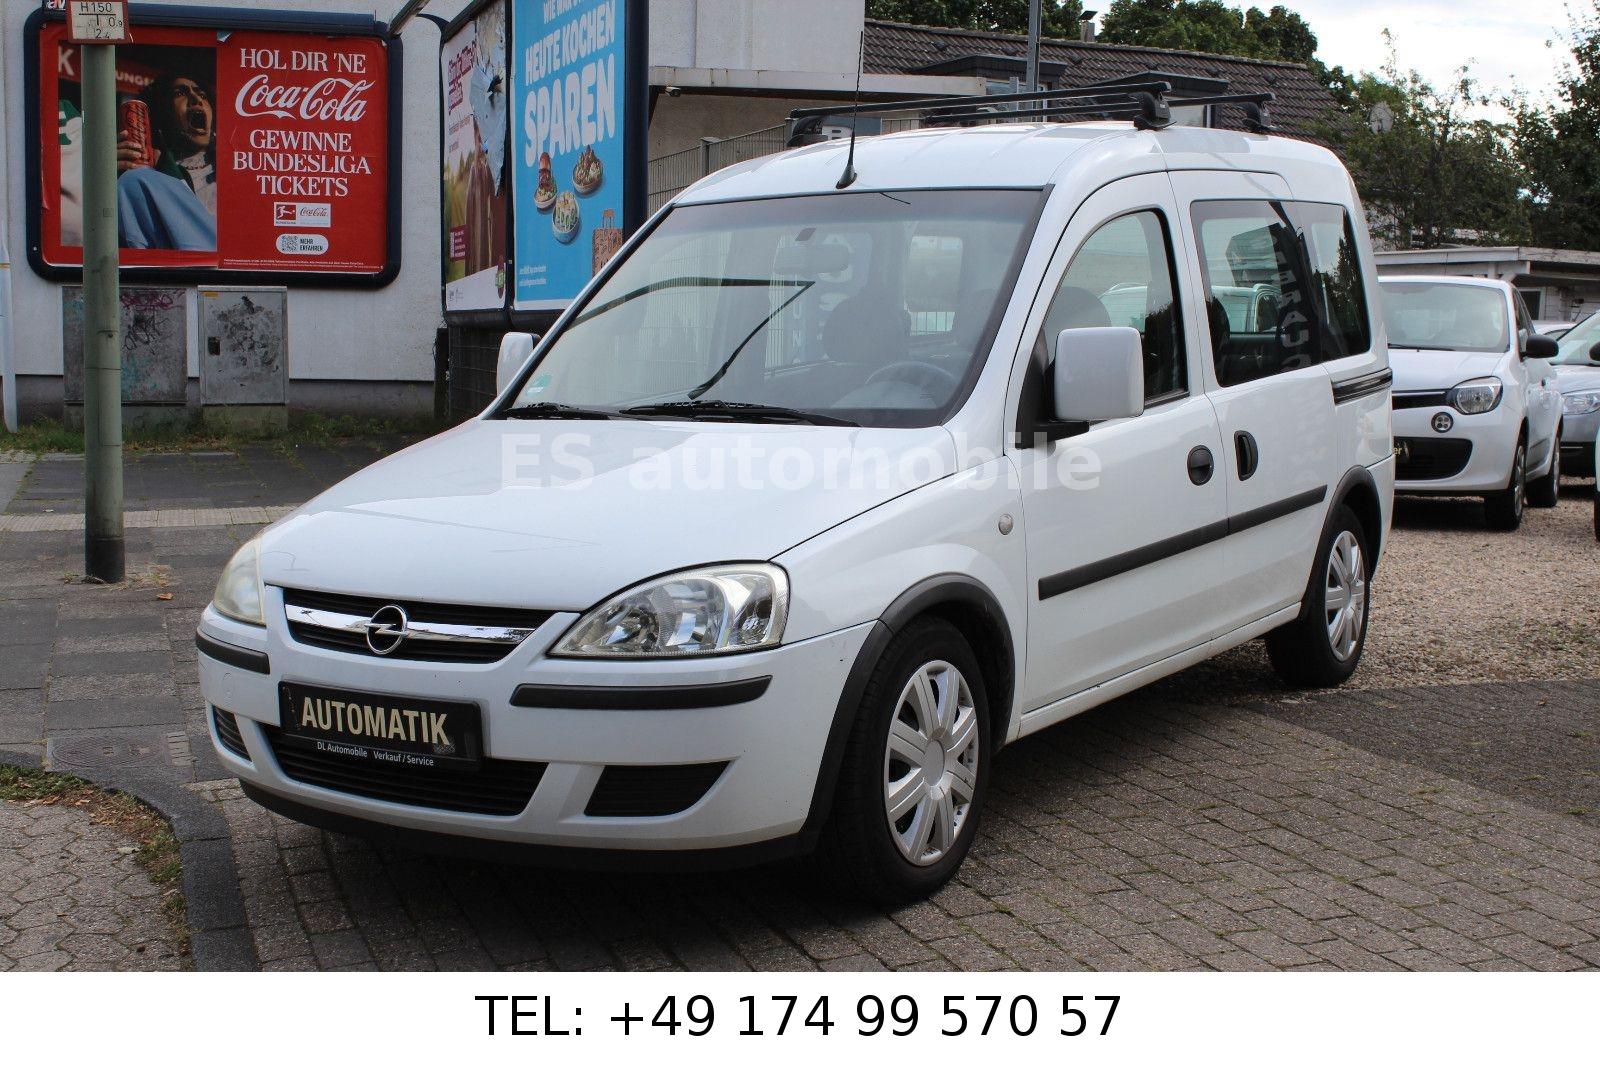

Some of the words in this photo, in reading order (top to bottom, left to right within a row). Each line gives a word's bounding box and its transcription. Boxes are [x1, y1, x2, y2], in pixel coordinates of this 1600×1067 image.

[81, 2, 113, 13] H150
[525, 29, 561, 87] HEUTE
[562, 0, 615, 67] KOCHEN
[240, 48, 287, 70] HOL
[291, 50, 329, 72] DIR
[333, 52, 366, 74] 'NE
[235, 74, 376, 122] Coca-Cola
[524, 53, 615, 167] SPAREN
[249, 129, 352, 153] GEWINNE
[232, 151, 372, 175] BUNDESLIGA
[256, 175, 349, 197] TICKETS
[302, 697, 450, 745] AUTOMATIK
[317, 741, 327, 750] DL
[327, 743, 368, 758] Automobile
[373, 750, 401, 763] Verkauf
[407, 754, 434, 766] Service
